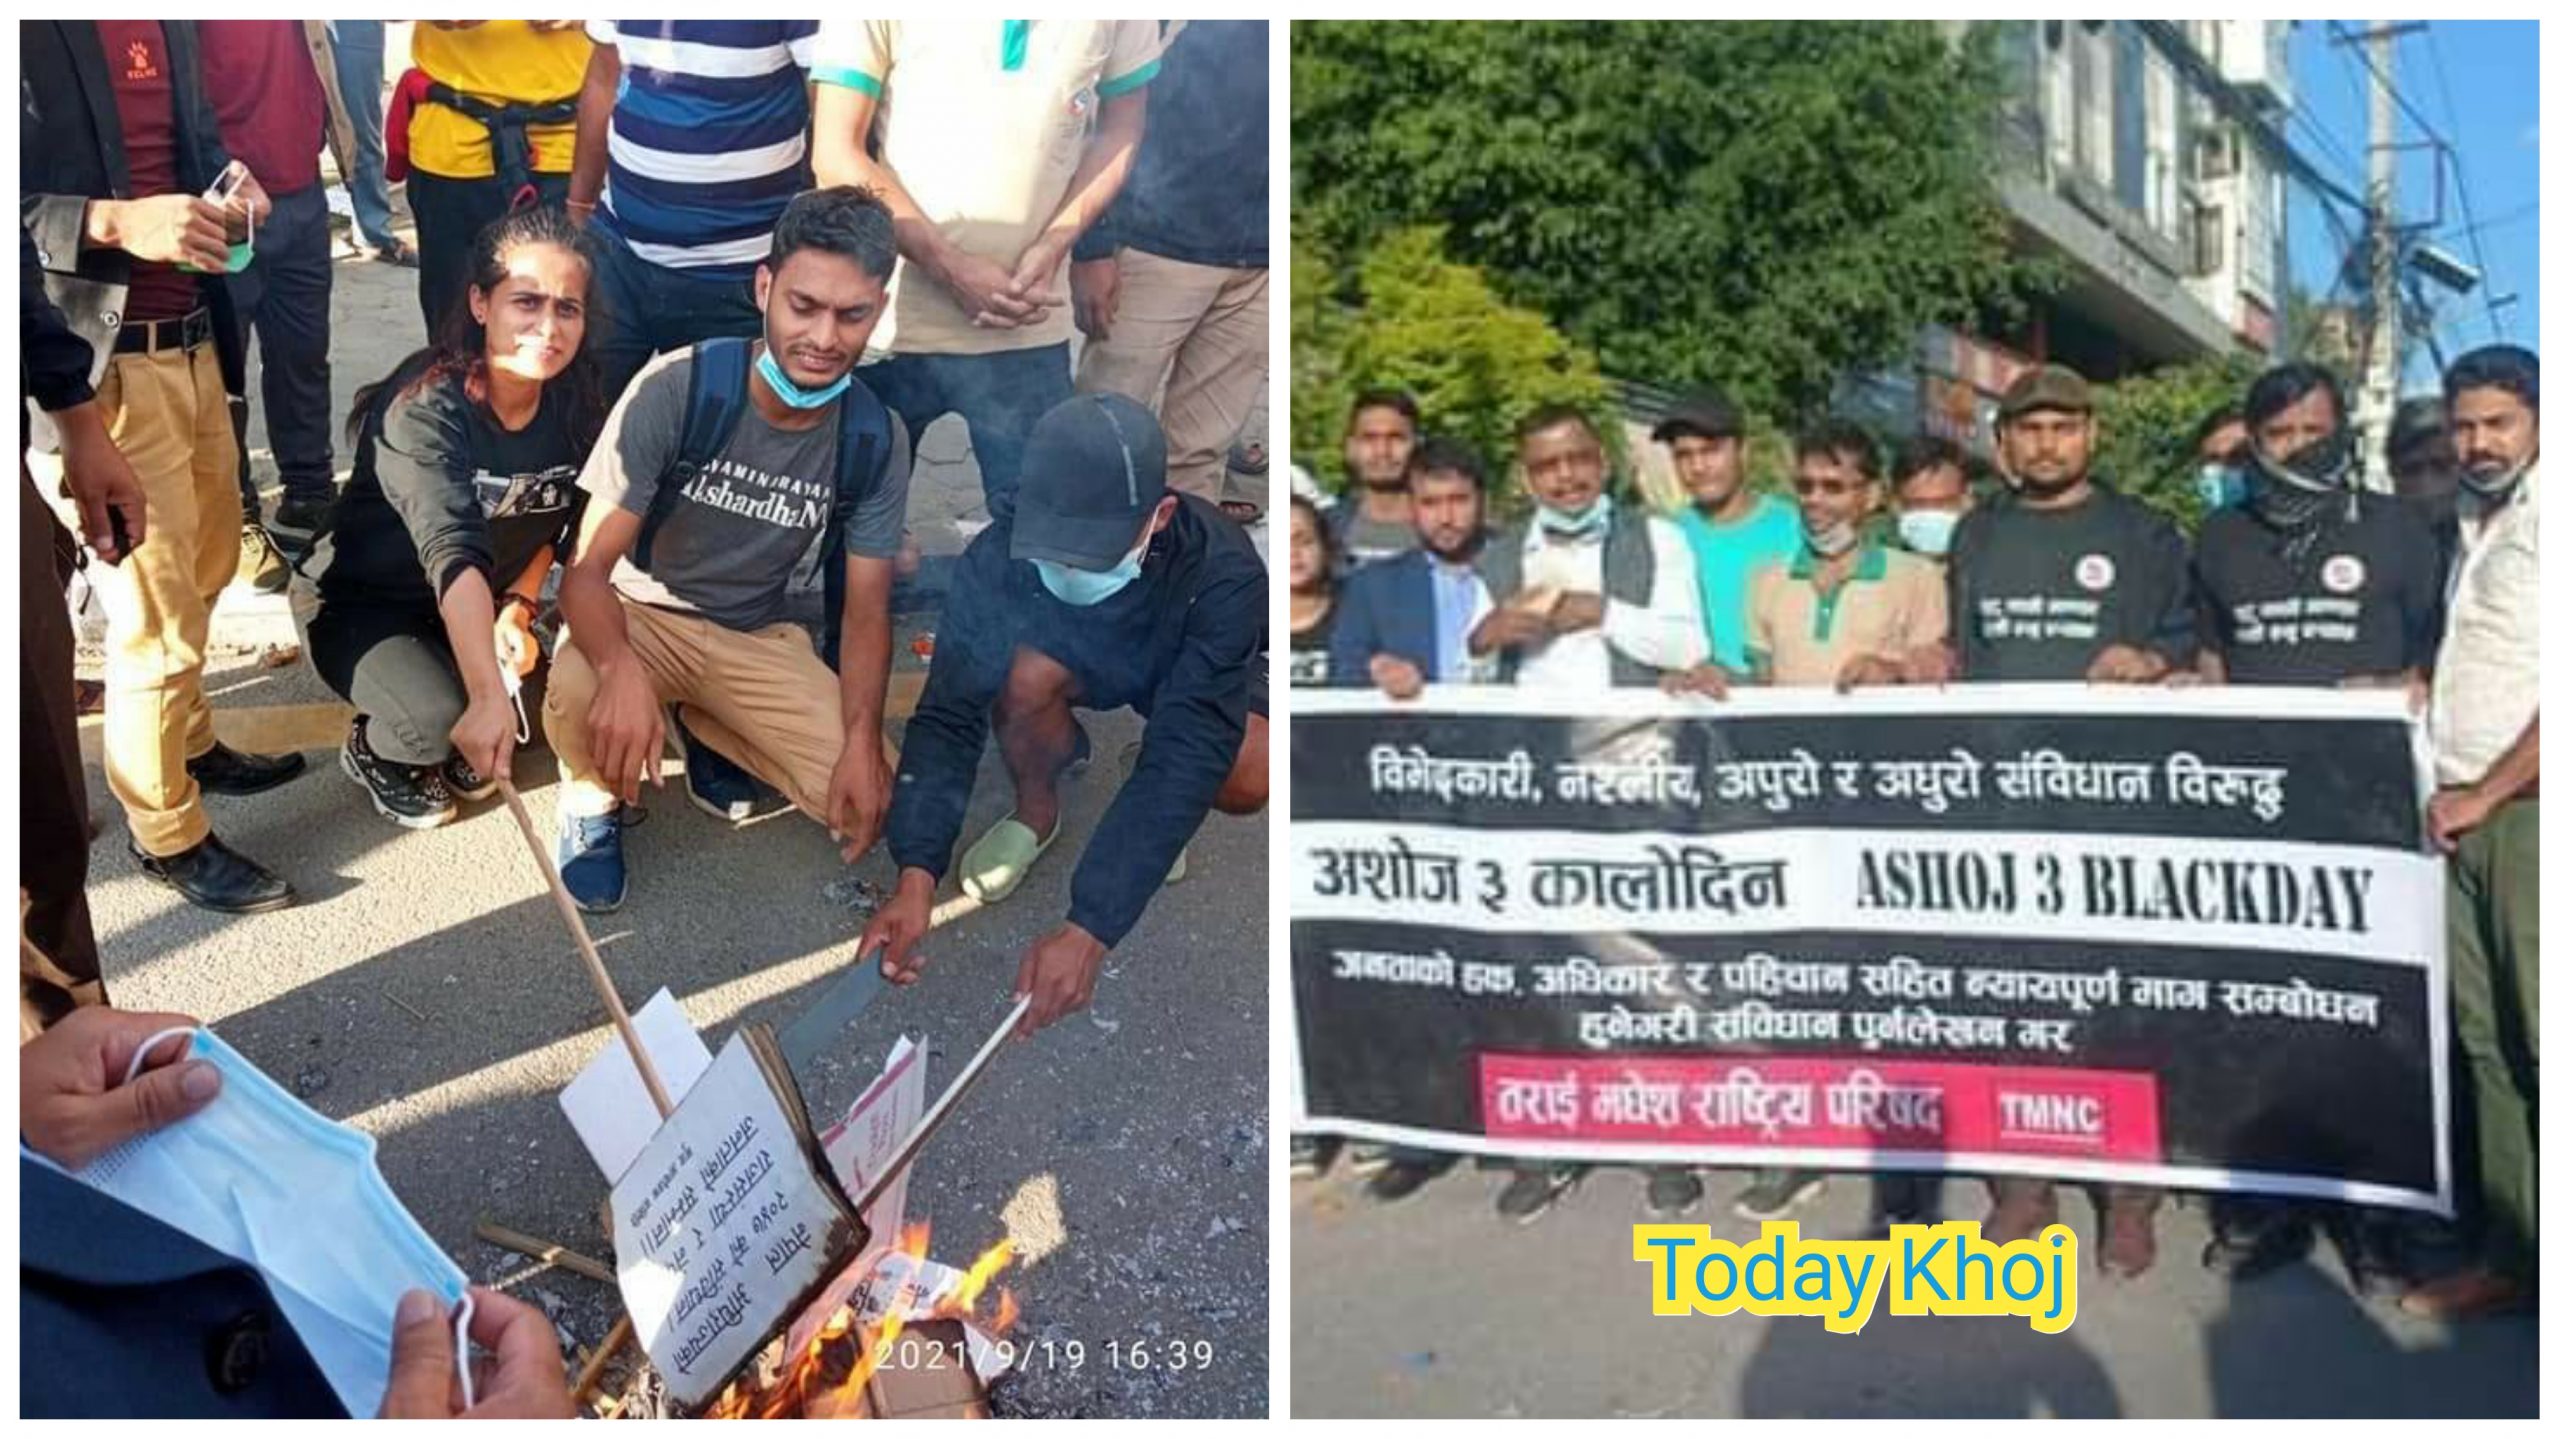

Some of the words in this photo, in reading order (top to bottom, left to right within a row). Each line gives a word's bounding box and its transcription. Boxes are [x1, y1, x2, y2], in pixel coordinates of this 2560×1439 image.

[1716, 749, 1819, 811] अपुरो
[1833, 762, 1860, 797] र
[1875, 749, 1980, 812] अधुरो
[1997, 748, 2151, 802] संविधान
[1309, 836, 1460, 903] अशोज
[1477, 860, 1507, 913] ३
[1532, 844, 1788, 913] कालोदिन
[1857, 848, 2017, 913] ASHOJ
[2036, 851, 2065, 915] 3
[2081, 854, 2373, 934] BLACKDAY
[1332, 949, 1454, 988] जनताको
[1533, 957, 1672, 998] अधिकार
[1686, 962, 1710, 996] र
[1723, 952, 1849, 998] पहिचान
[1860, 954, 1952, 1001] सहित
[2131, 976, 2206, 1012] माग
[2221, 978, 2380, 1028] सम्बोधन
[1500, 1072, 1577, 1129] तराई
[1591, 1073, 1681, 1128] मधेश
[2000, 1092, 2103, 1133] TMNC
[700, 1115, 761, 1195] जनताको
[692, 1228, 708, 1251] र
[730, 1233, 752, 1268] को
[764, 1221, 814, 1277] नेपाल
[672, 1281, 753, 1376] अधिराज्यको
